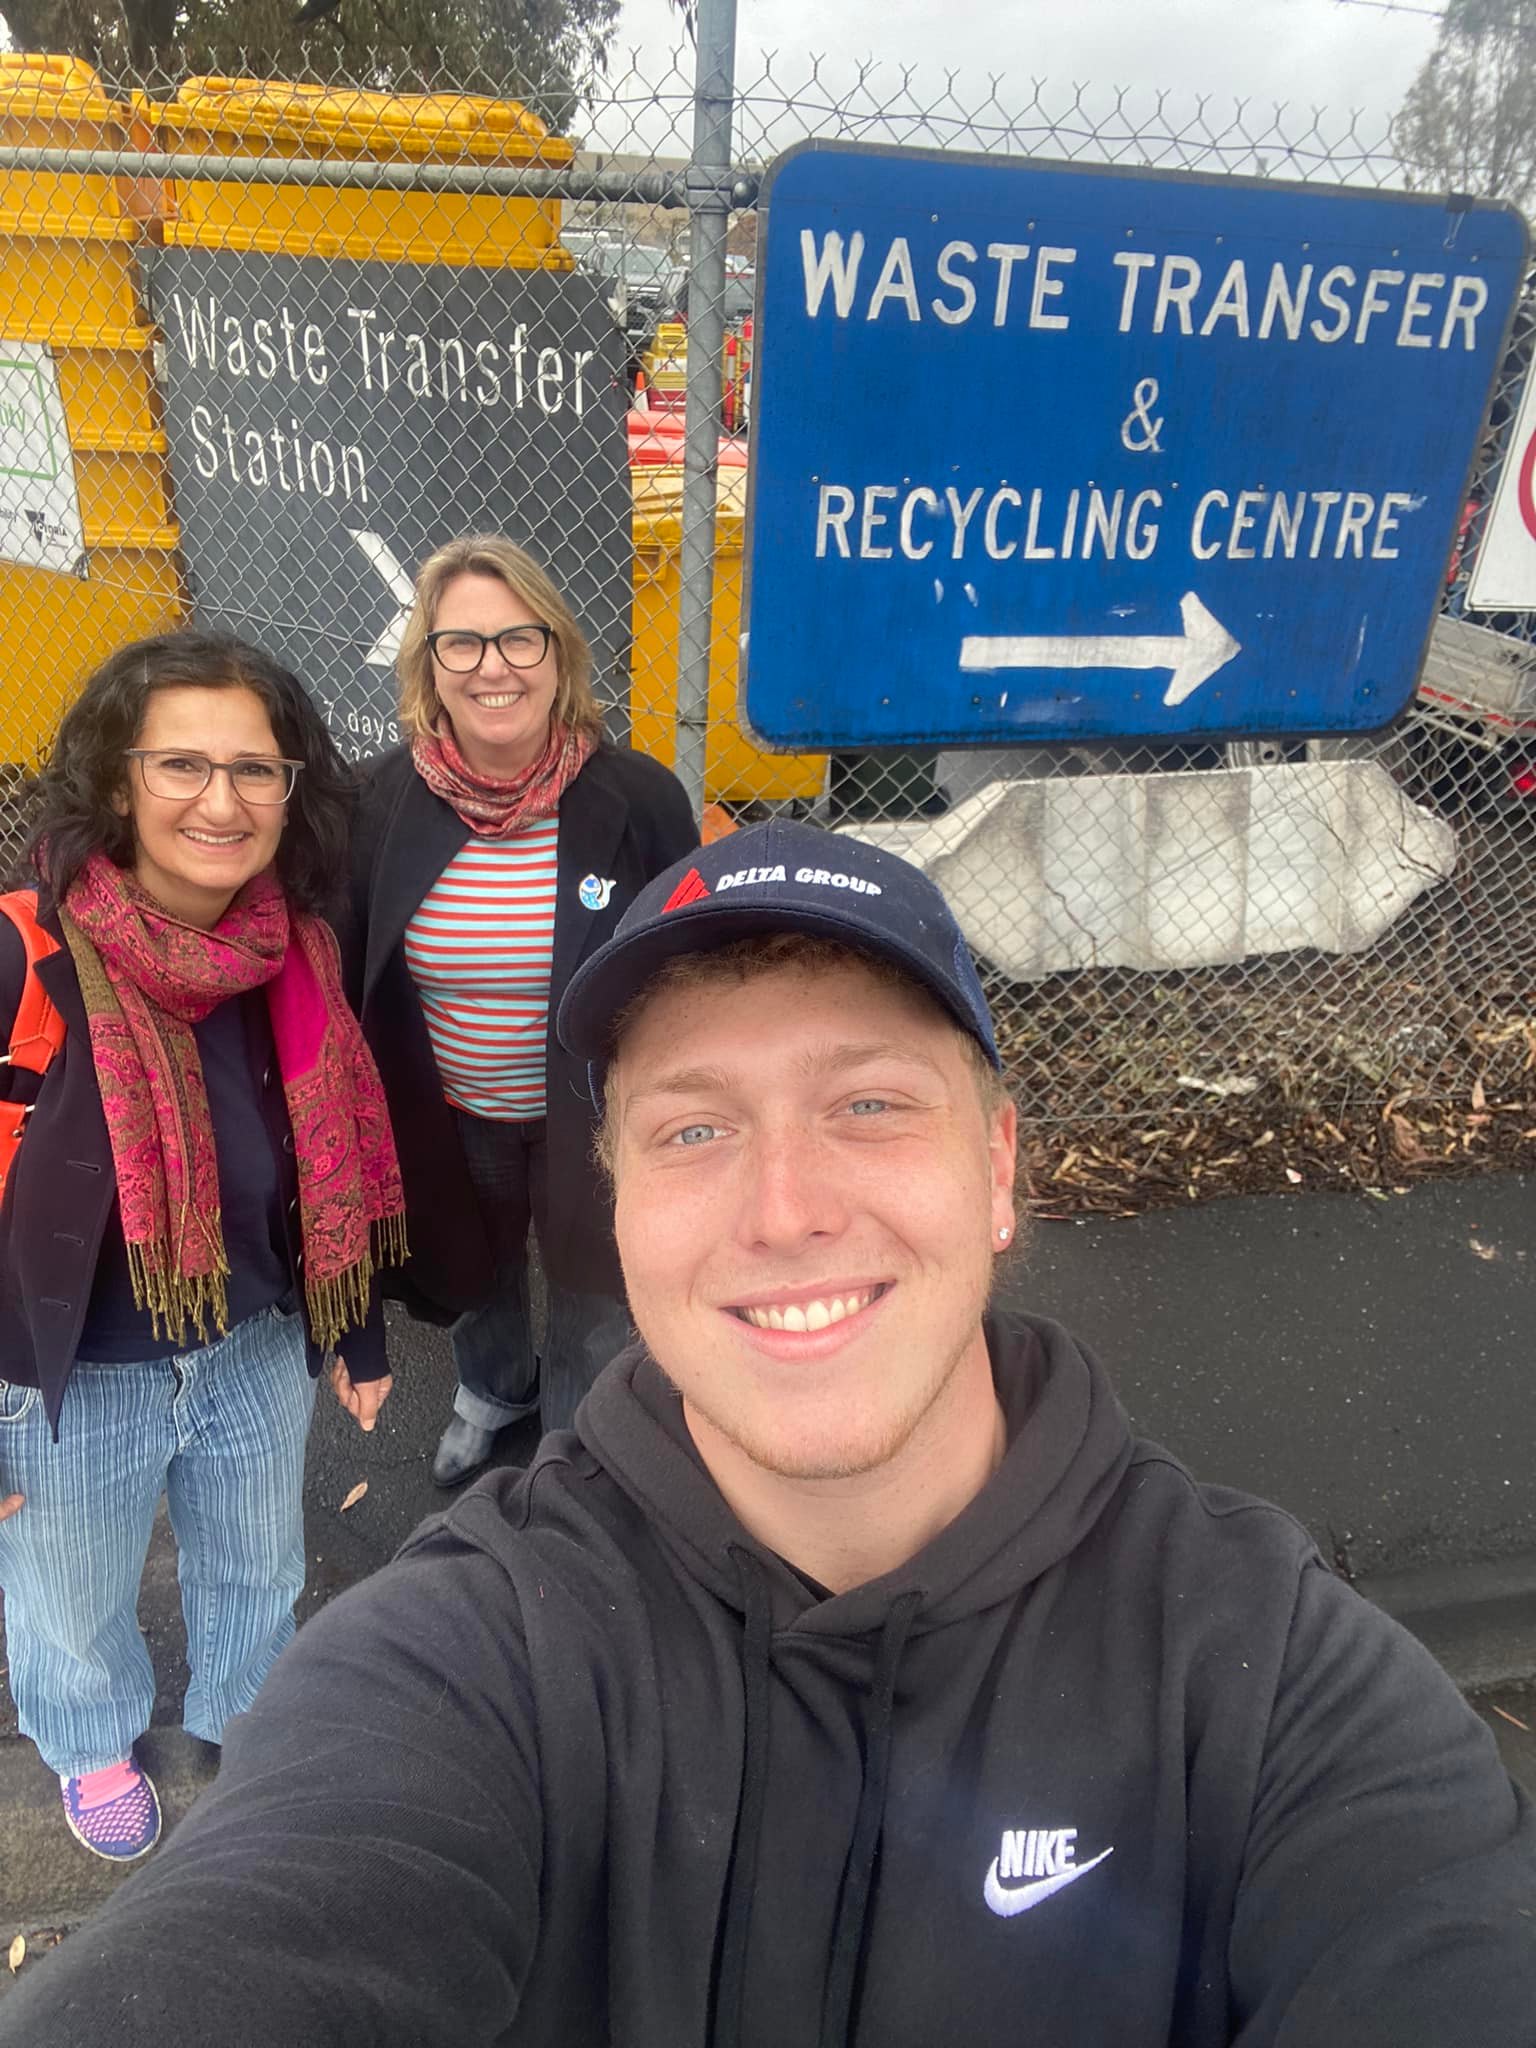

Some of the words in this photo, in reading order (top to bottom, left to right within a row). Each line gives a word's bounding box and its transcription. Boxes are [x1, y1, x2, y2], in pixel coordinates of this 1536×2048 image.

[800, 229, 1077, 330] WASTE
[1113, 251, 1489, 351] TRANSFER
[173, 293, 328, 385] Waste
[347, 307, 594, 416] Transfer
[1121, 377, 1164, 452] &
[190, 405, 368, 503] Station
[815, 484, 1163, 560] RECYCLING
[1191, 490, 1411, 560] CENTRE
[323, 700, 335, 726] 7
[348, 706, 398, 744] days
[715, 865, 787, 893] DELTA
[794, 867, 883, 897] GROUP
[1000, 1828, 1078, 1878] NIKE
